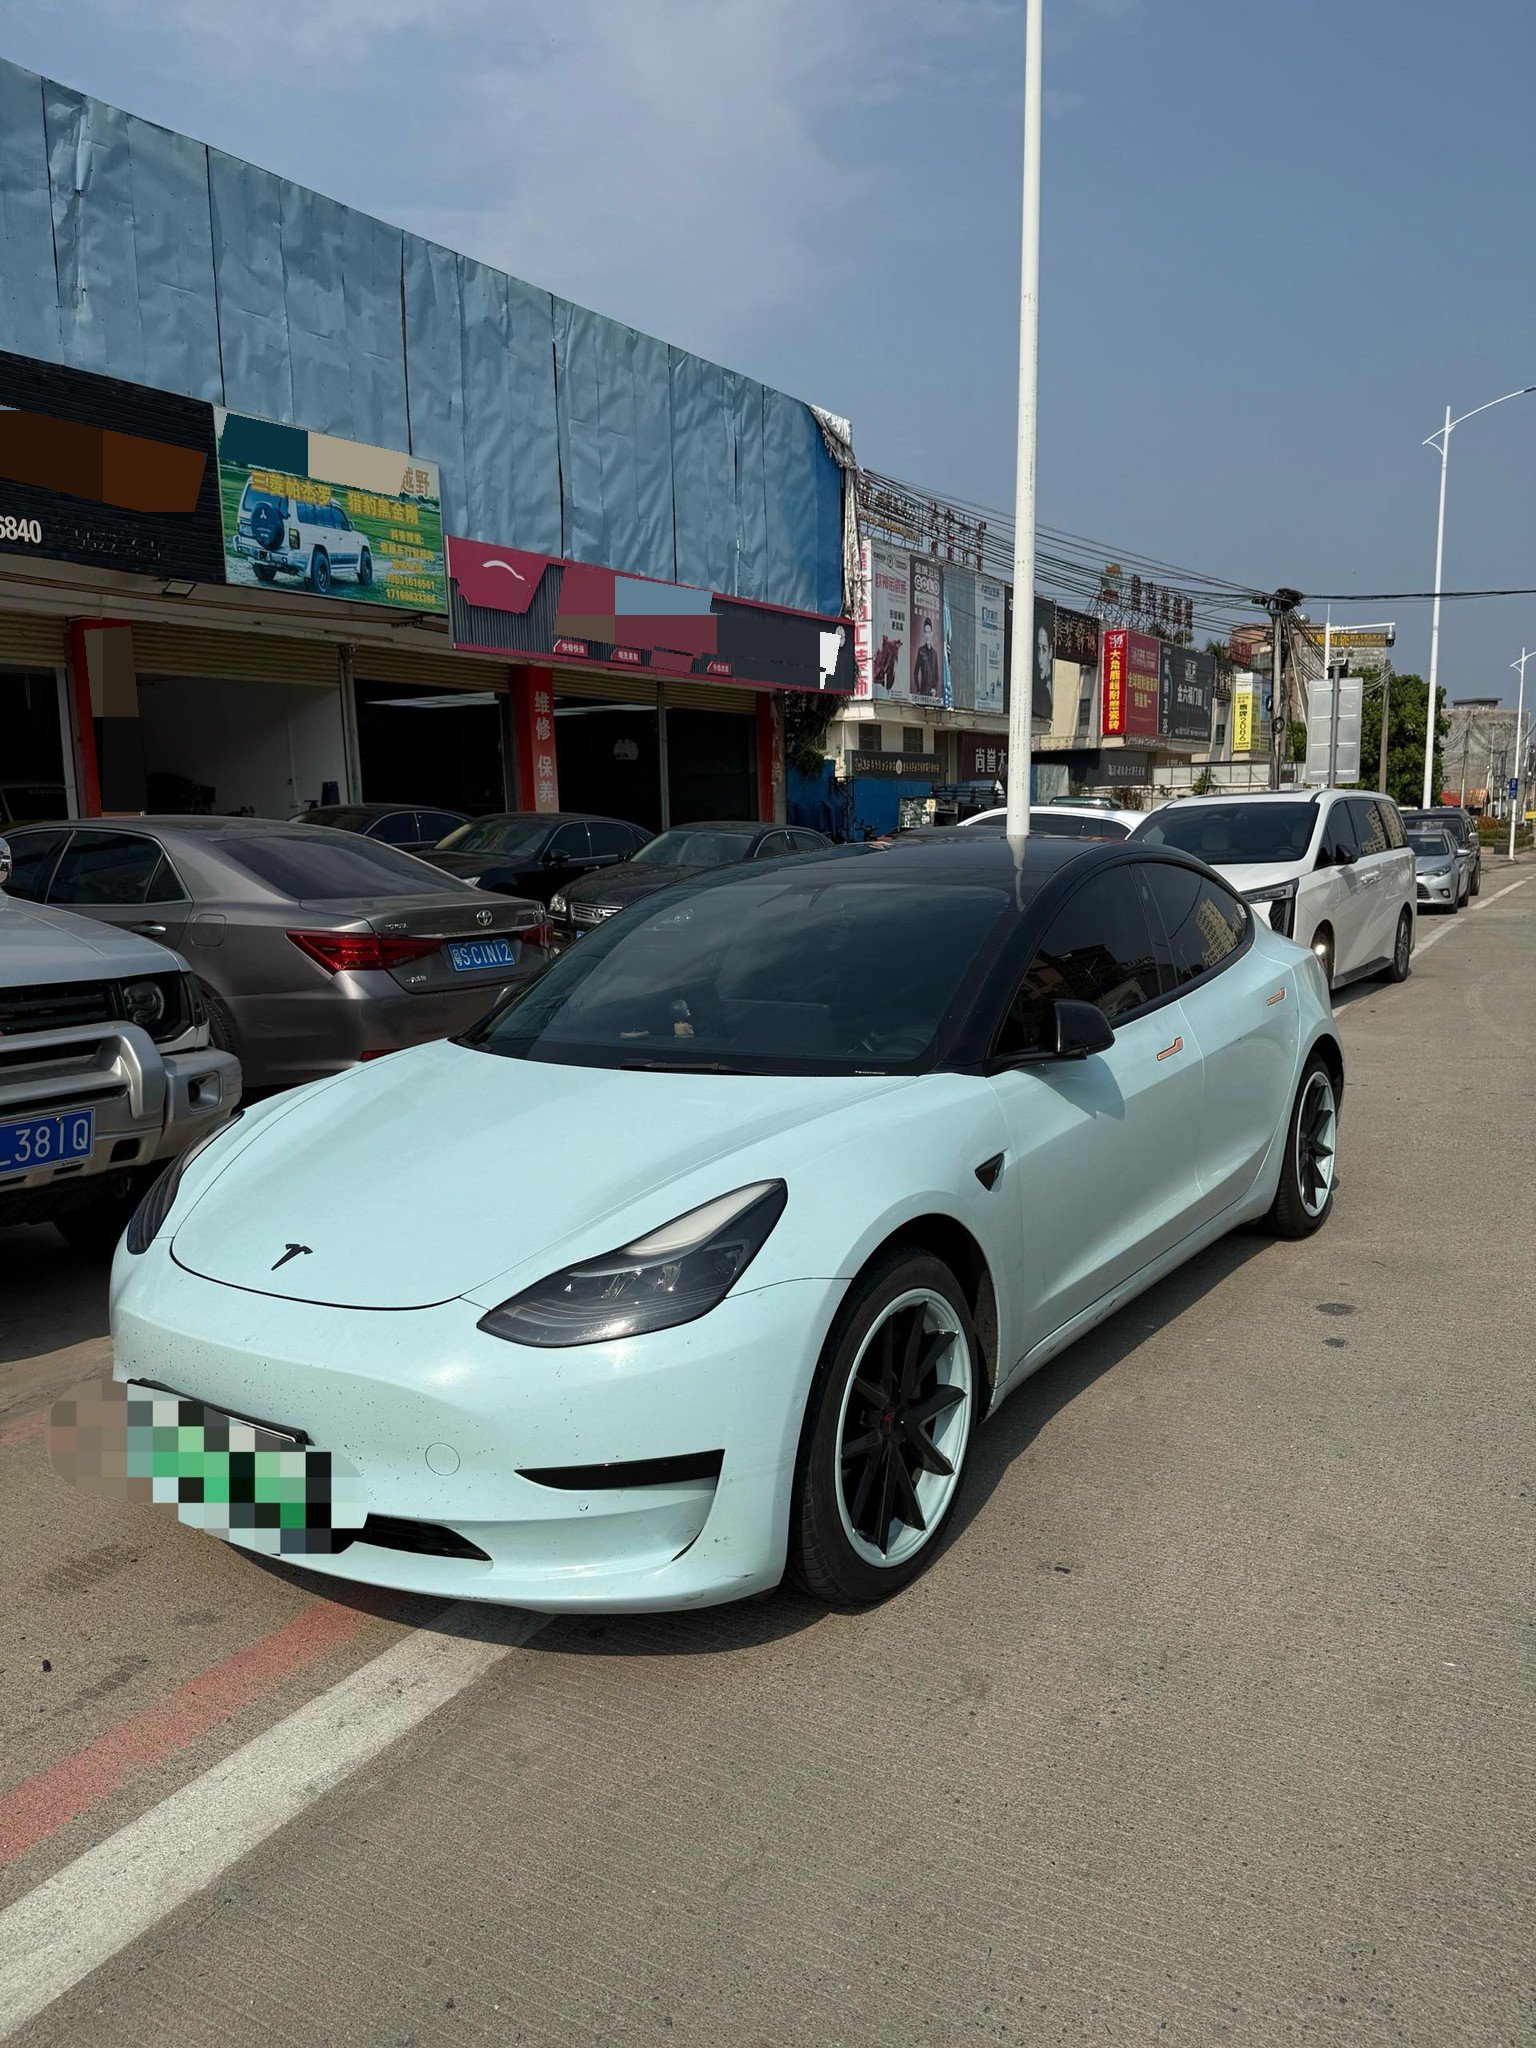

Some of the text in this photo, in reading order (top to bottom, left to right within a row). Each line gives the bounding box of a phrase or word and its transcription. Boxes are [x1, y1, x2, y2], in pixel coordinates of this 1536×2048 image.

[346, 490, 418, 525] 猎豹黑金刚
[535, 691, 554, 803] 维修 保养
